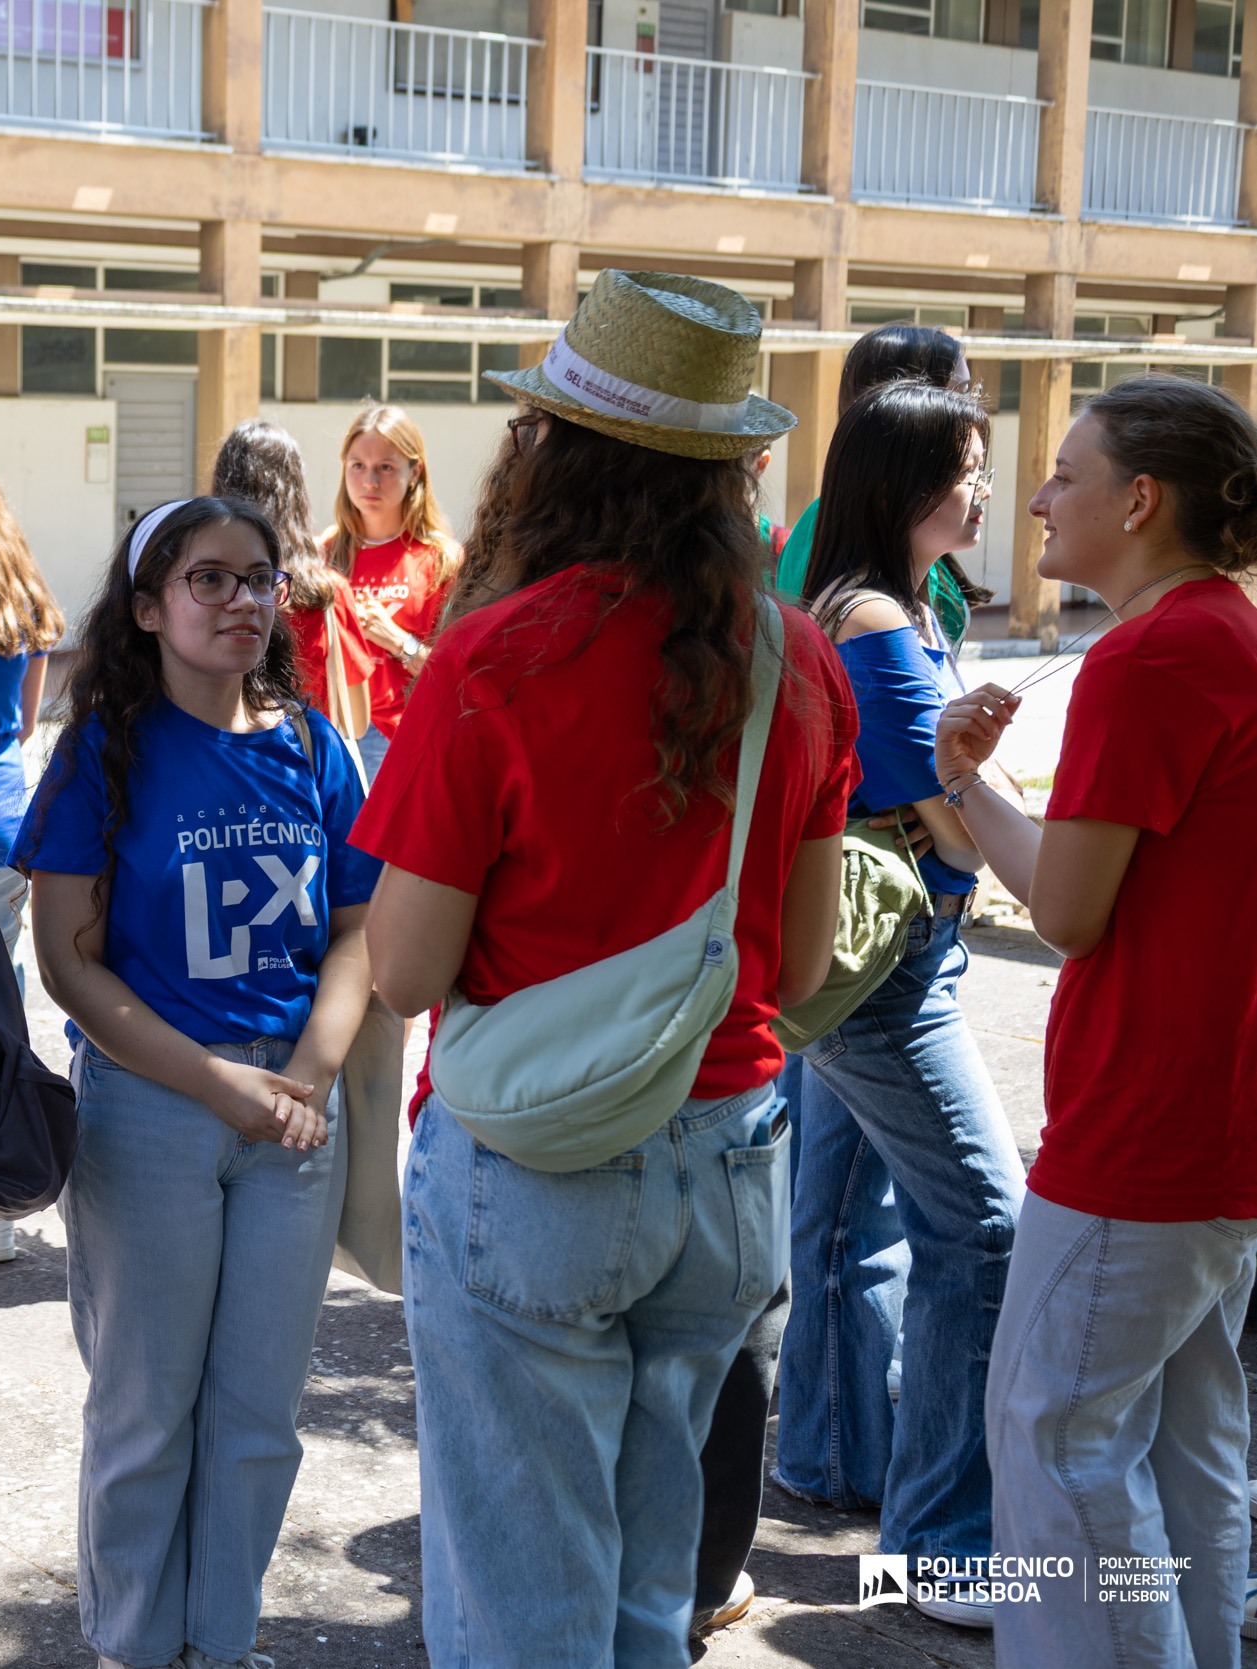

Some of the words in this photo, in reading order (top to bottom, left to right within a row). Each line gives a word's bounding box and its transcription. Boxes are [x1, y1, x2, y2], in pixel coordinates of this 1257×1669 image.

[564, 368, 583, 388] ISEL
[582, 385, 617, 407] ENGENHARIA
[616, 401, 625, 410] DE
[625, 405, 649, 418] LISBOA
[585, 380, 611, 397] INSTITUTO
[610, 393, 642, 408] SUPERIOR
[641, 403, 652, 412] DE
[178, 818, 322, 854] POLITÉCNICO
